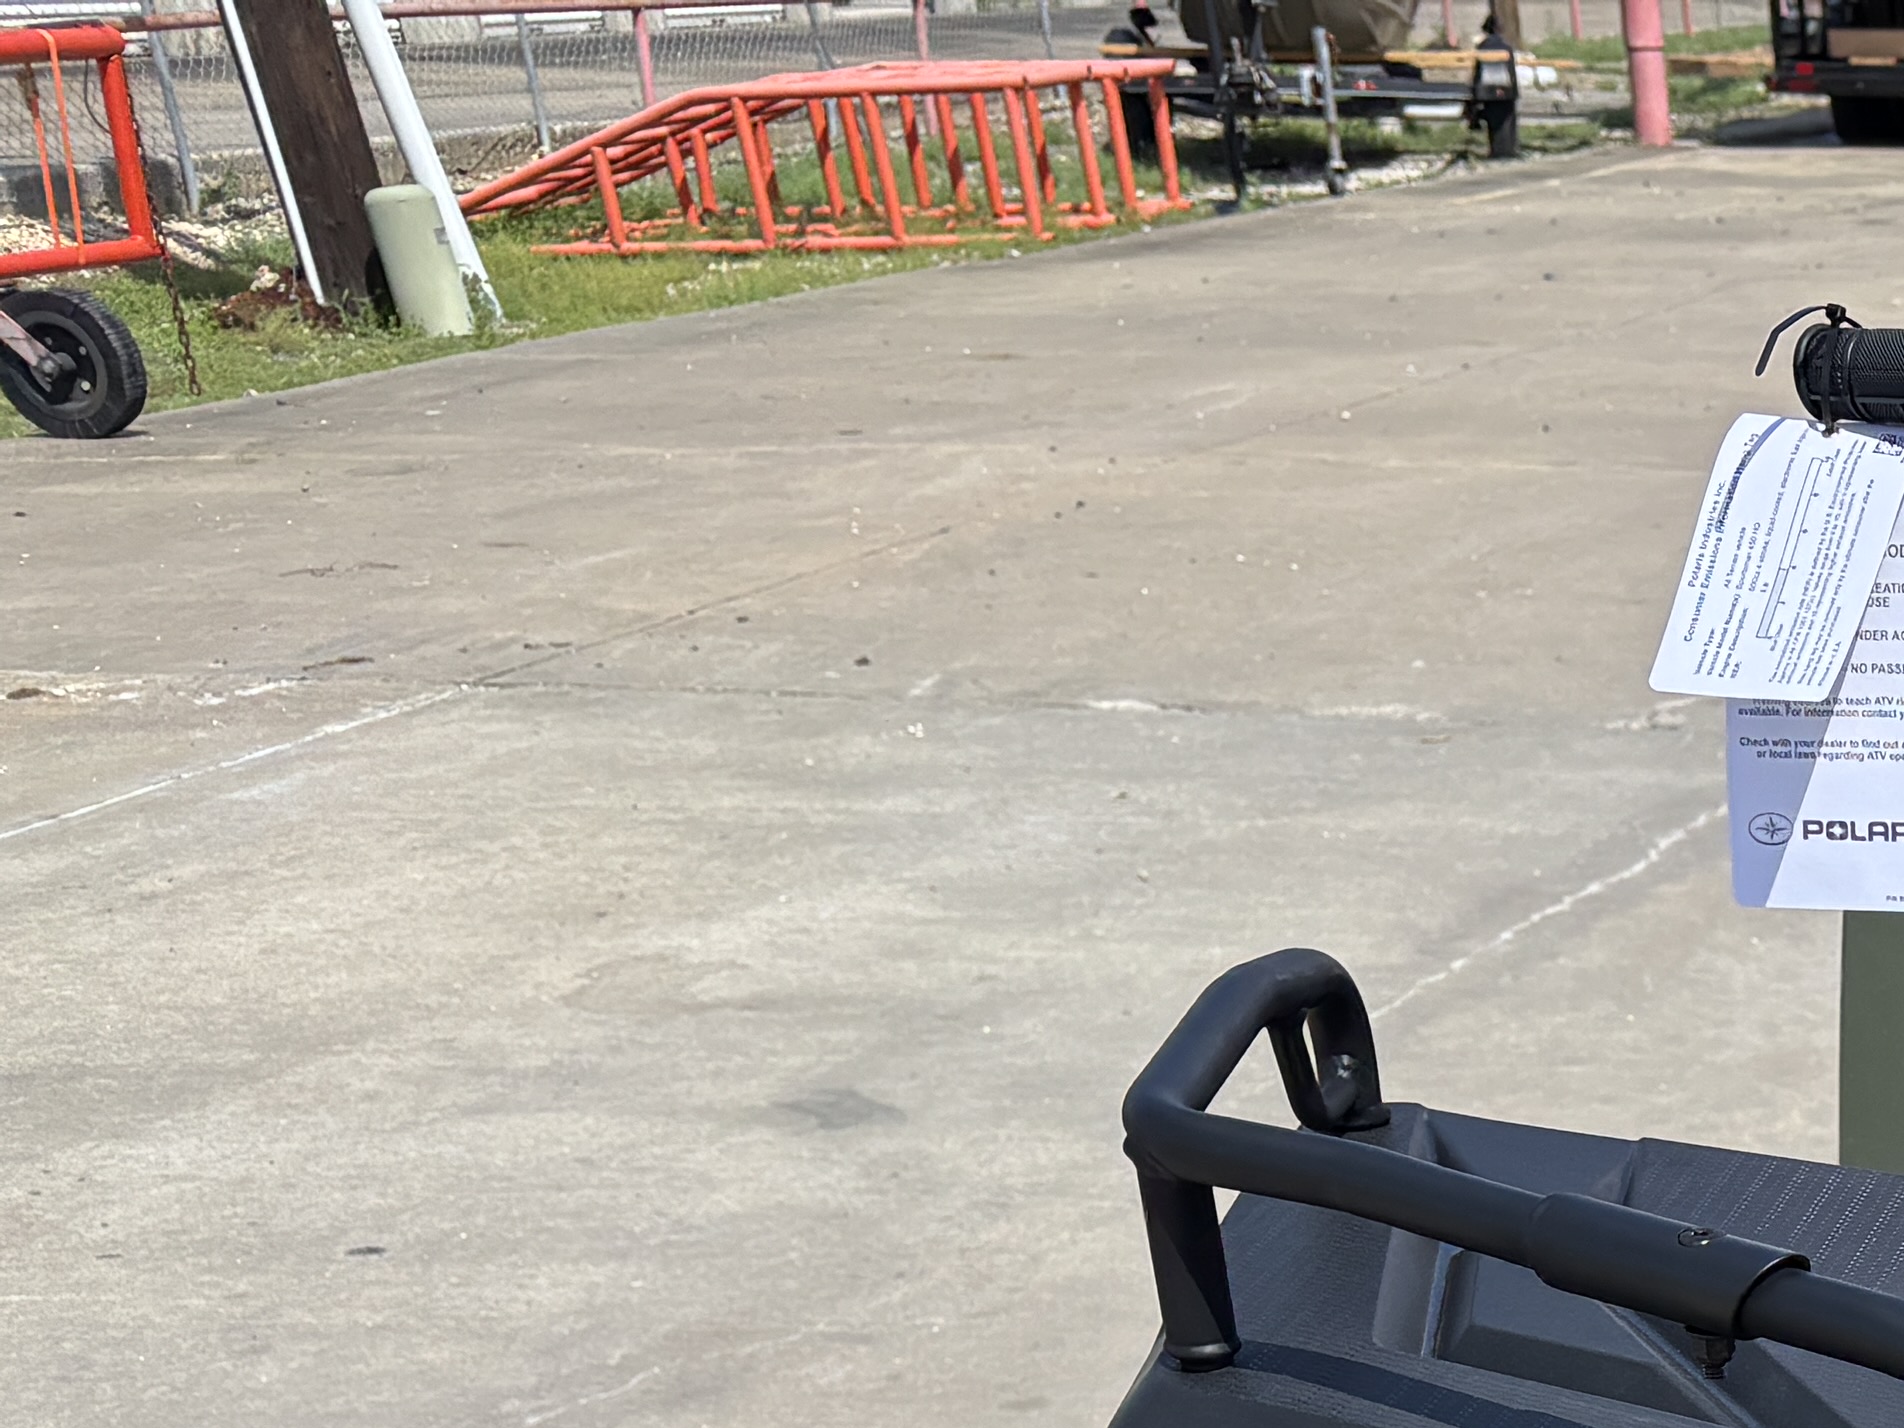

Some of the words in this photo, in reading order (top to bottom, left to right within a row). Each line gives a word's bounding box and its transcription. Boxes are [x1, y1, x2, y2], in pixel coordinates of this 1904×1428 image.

[1850, 663, 1867, 674] NO
[1874, 697, 1894, 705] ATV
[1739, 737, 1769, 746] Check
[1867, 751, 1887, 760] ATV
